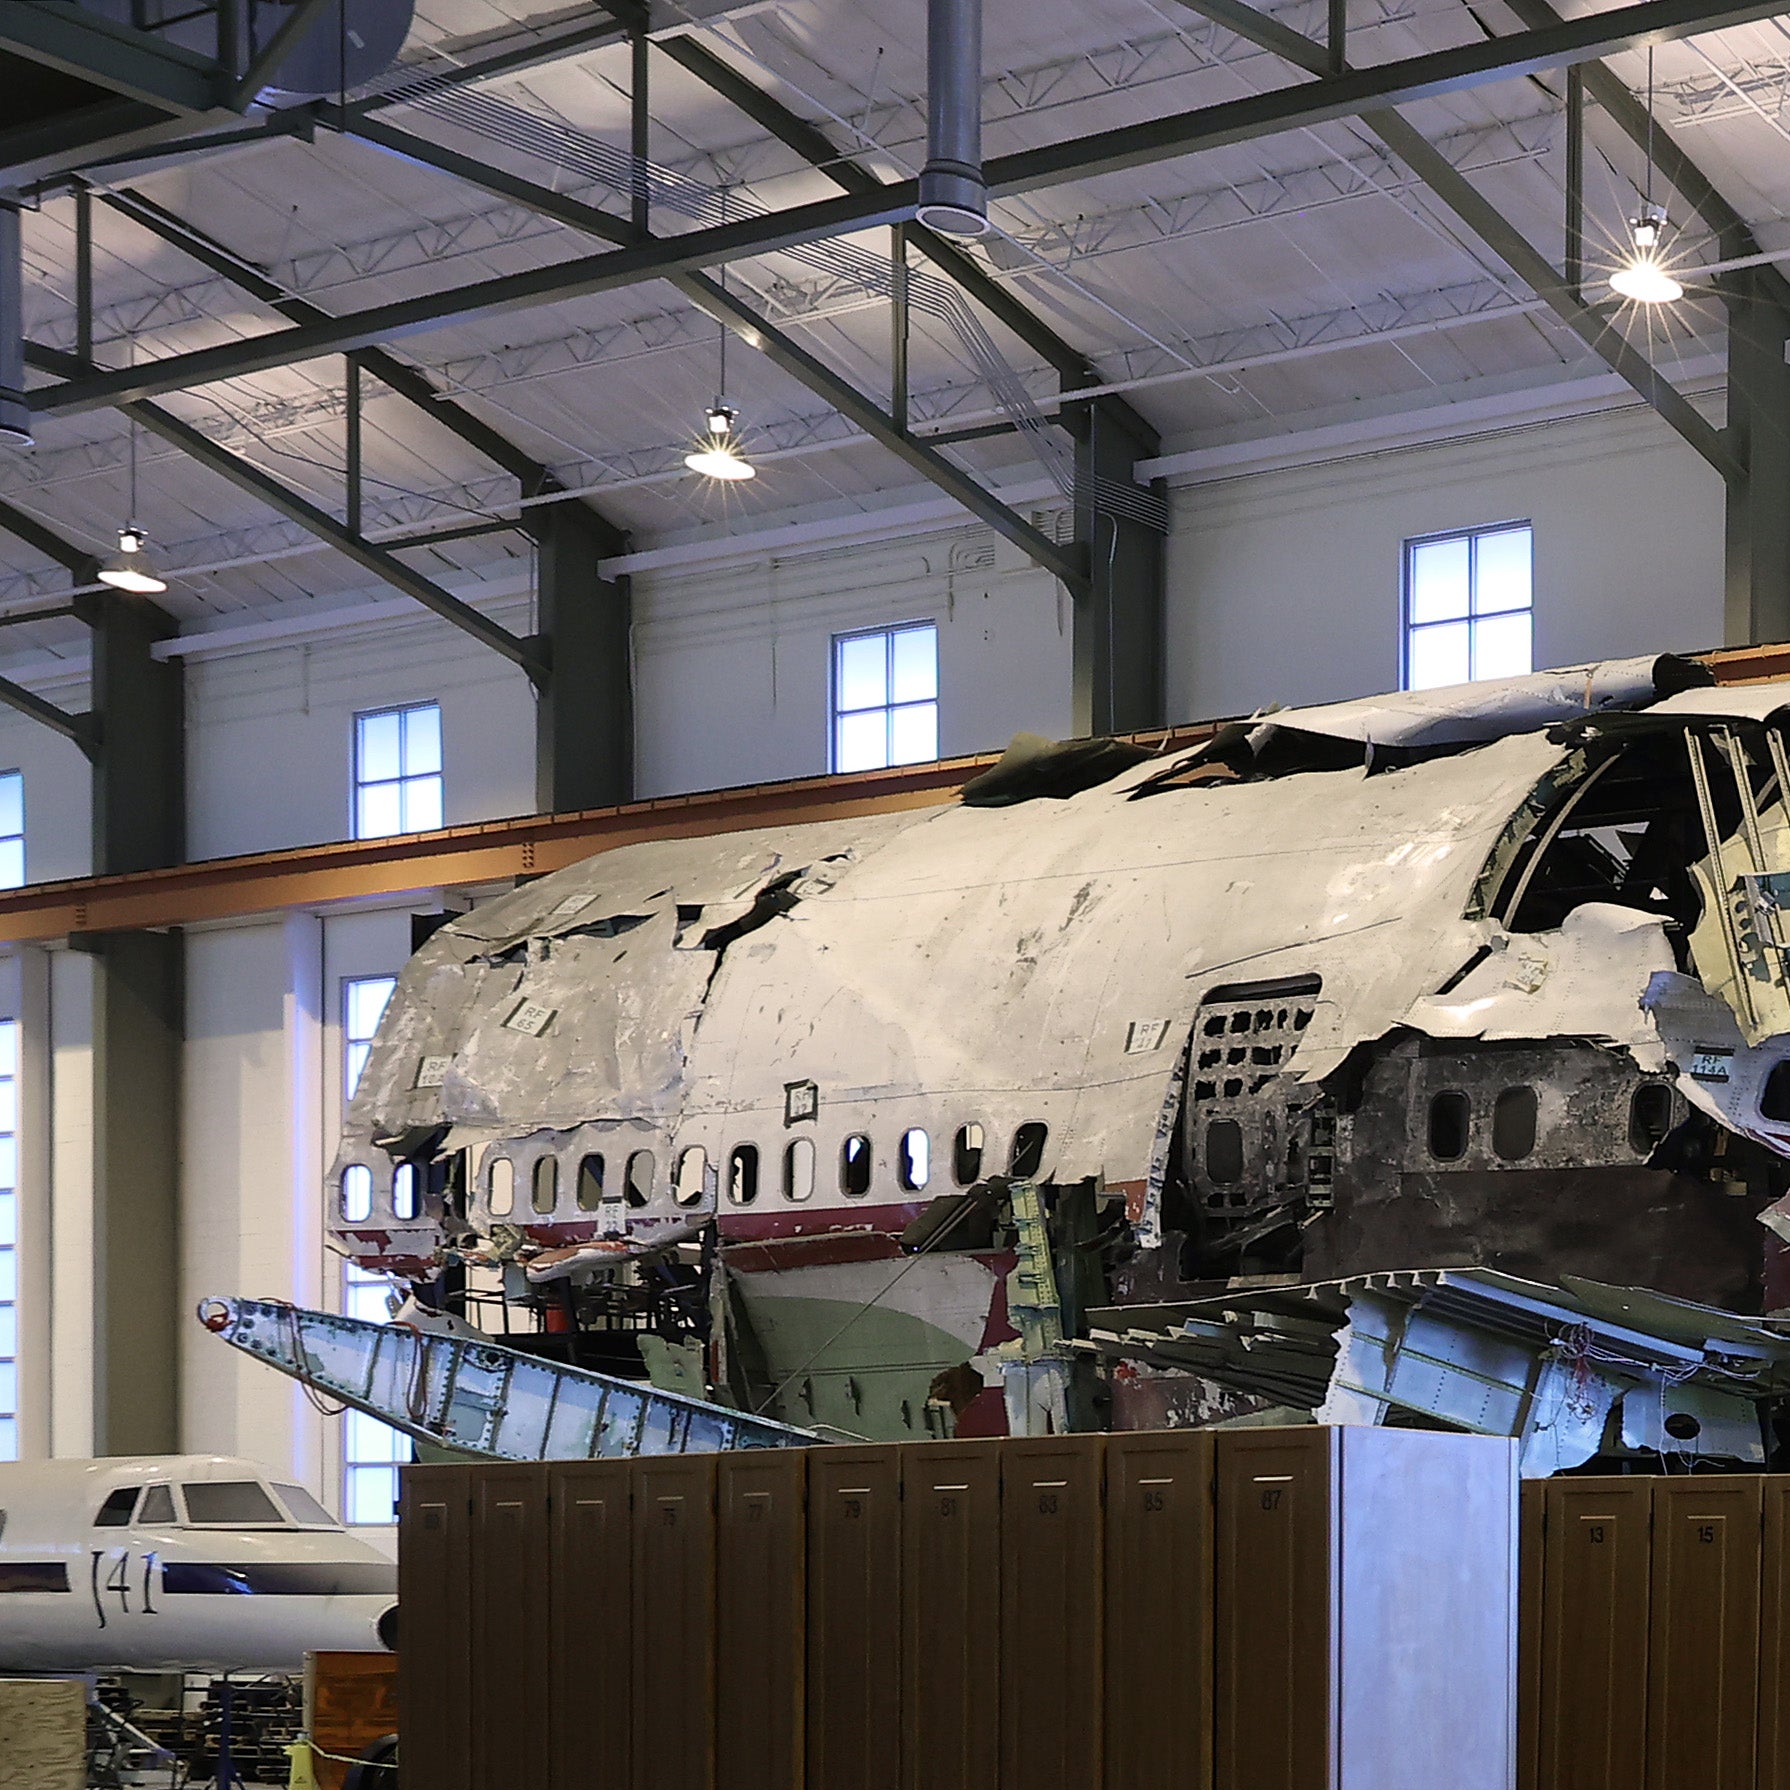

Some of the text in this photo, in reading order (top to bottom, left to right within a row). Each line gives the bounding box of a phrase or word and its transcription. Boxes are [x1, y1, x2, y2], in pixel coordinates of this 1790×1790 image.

[525, 1007, 545, 1019] RF
[516, 1018, 533, 1031] 65
[1141, 1023, 1158, 1034] RF
[429, 1061, 446, 1072] RF
[1702, 1056, 1723, 1064] RF
[1693, 1065, 1727, 1074] 114A
[1145, 1492, 1163, 1512] 85
[1262, 1490, 1282, 1510] 87
[1590, 1526, 1604, 1544] 13
[1697, 1525, 1714, 1543] 15
[90, 1550, 159, 1629] J41
